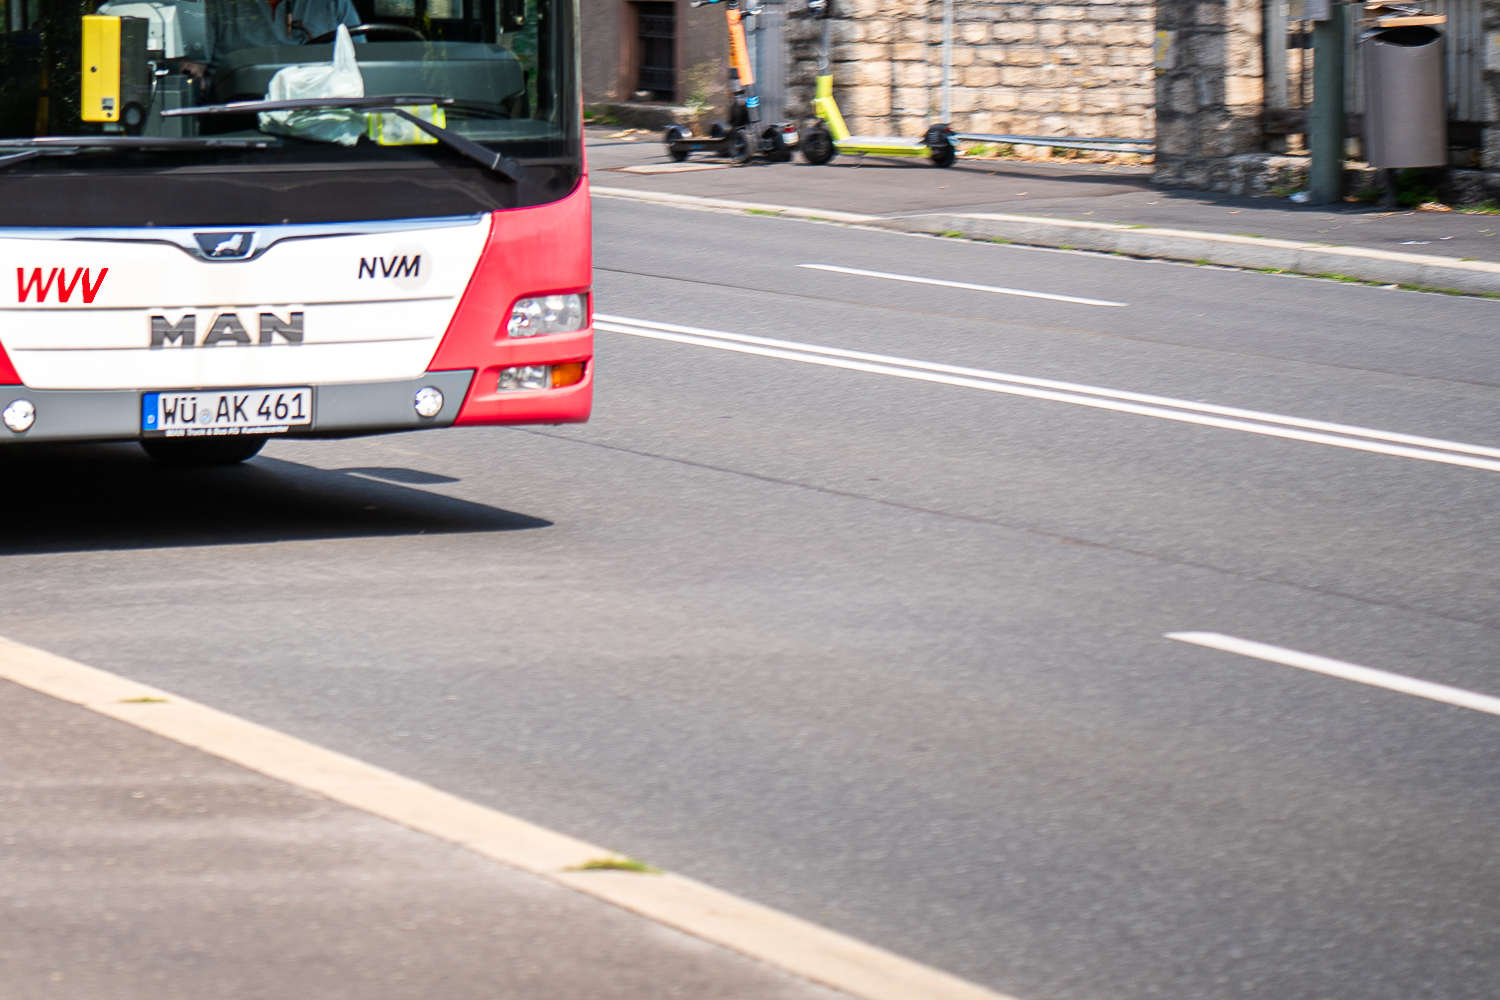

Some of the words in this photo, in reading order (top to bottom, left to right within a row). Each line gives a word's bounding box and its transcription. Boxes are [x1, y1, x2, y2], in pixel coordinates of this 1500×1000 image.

[358, 253, 422, 279] NVM
[16, 267, 109, 304] WVV
[150, 311, 305, 350] MAN
[161, 396, 197, 425] WÜ
[214, 394, 250, 423] AK
[256, 392, 306, 421] 461
